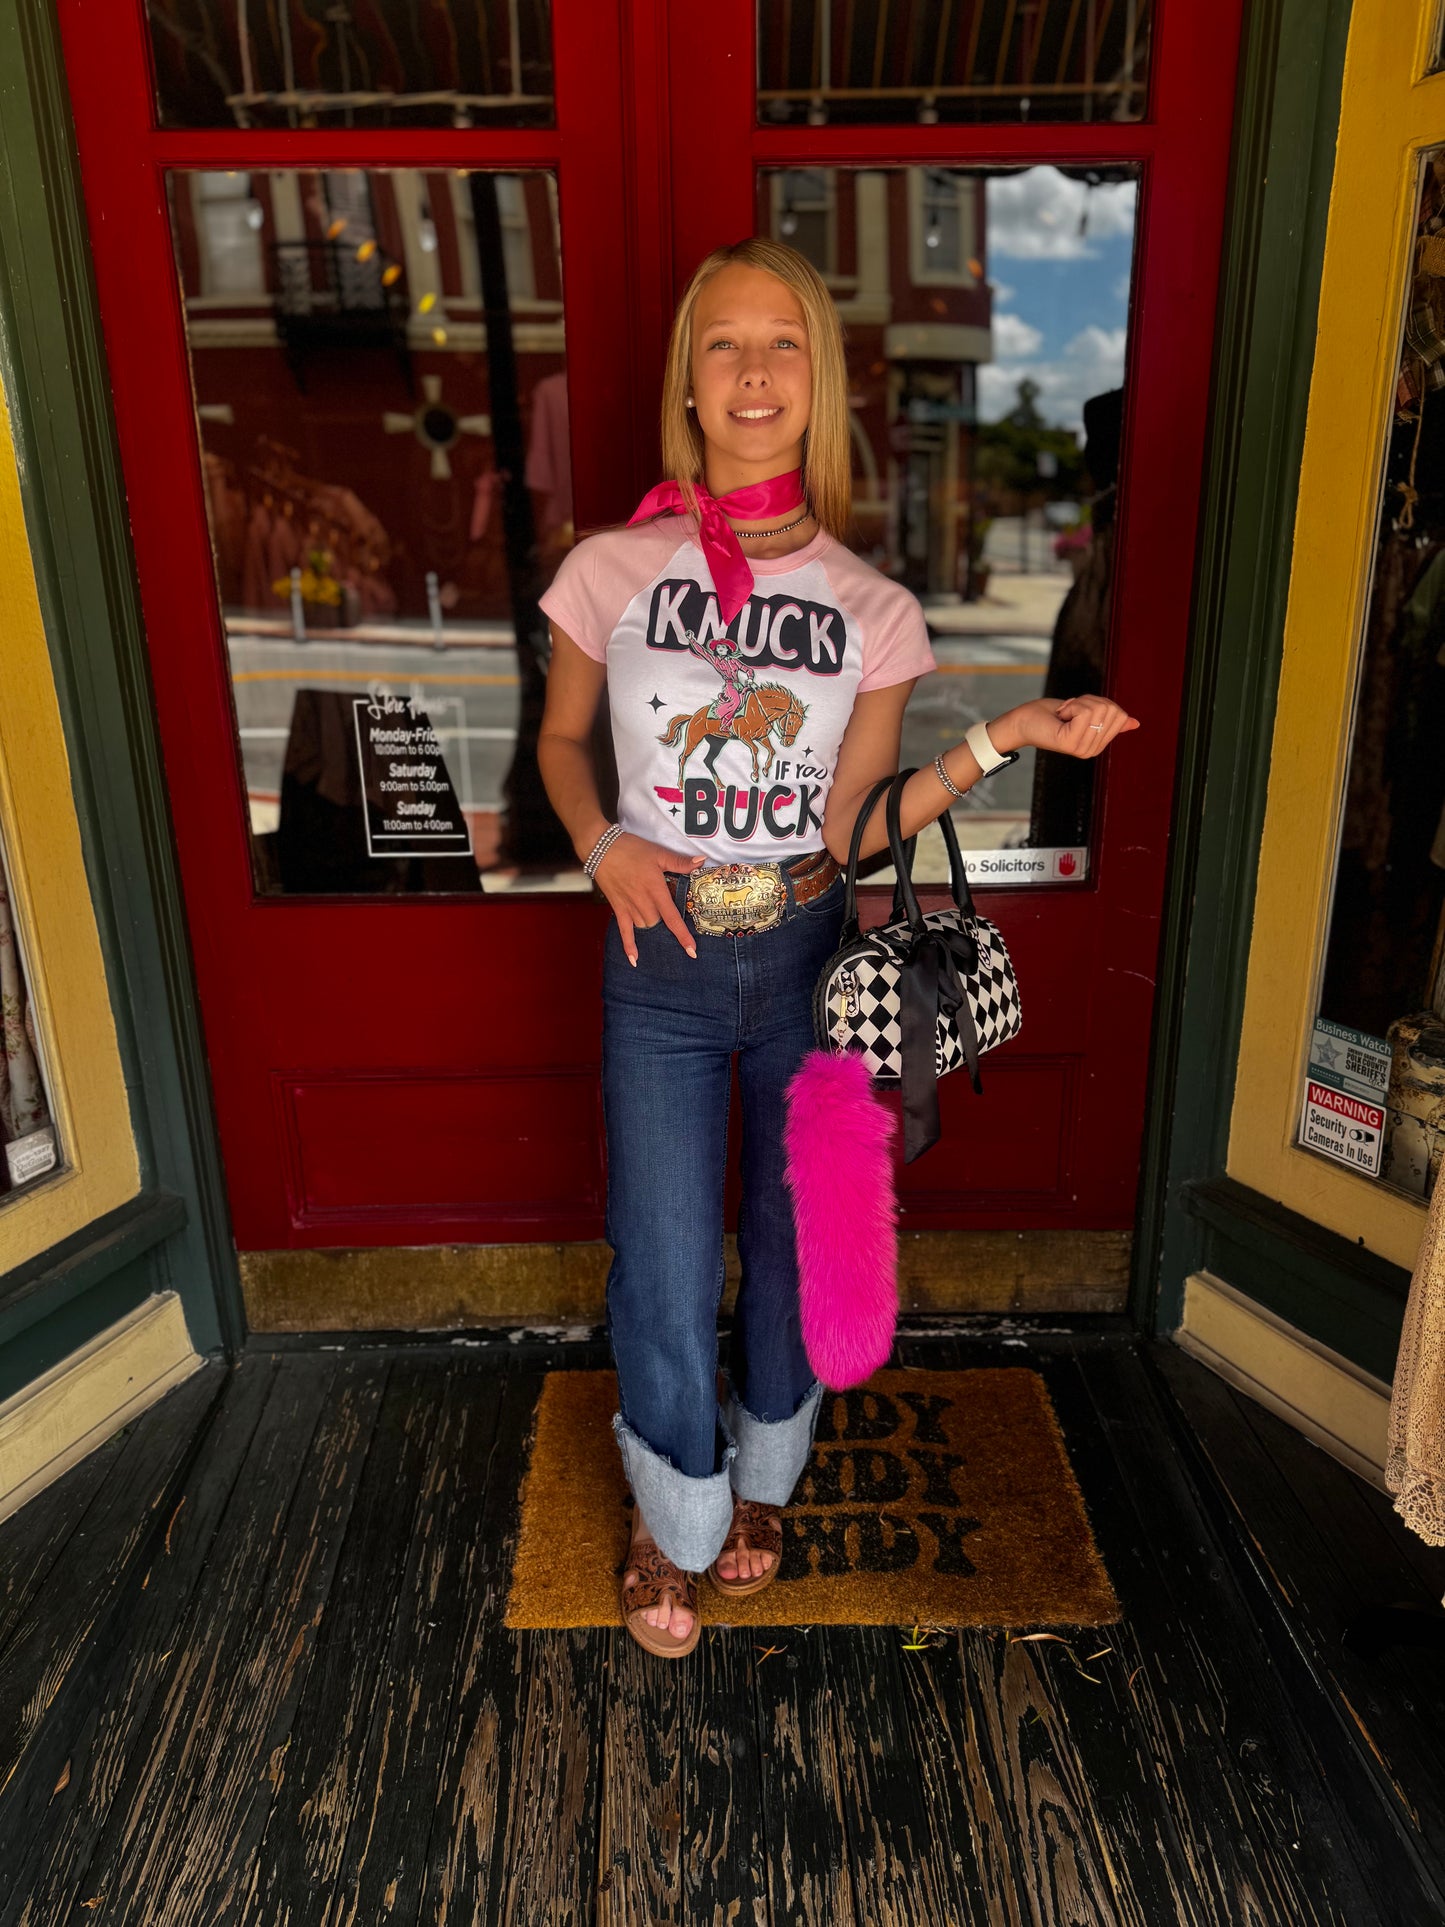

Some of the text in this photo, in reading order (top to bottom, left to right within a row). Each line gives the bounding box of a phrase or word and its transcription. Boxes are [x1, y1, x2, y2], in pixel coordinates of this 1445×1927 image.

[653, 583, 838, 665] KNUCK
[408, 745, 417, 755] to
[389, 763, 437, 780] Saturday
[775, 760, 829, 781] IF YOU
[379, 781, 410, 792] 9:00am
[410, 781, 419, 792] to
[397, 801, 437, 817] Sunday
[683, 777, 824, 841] BUCK
[414, 820, 423, 831] to
[423, 820, 453, 832] 4:00pm
[965, 859, 1046, 873] o Solicitors
[1316, 1019, 1392, 1056] Business Watch
[1346, 1053, 1387, 1073] POLK COUNTY
[1311, 1086, 1379, 1126] WARNING
[1310, 1108, 1347, 1139] Security
[1308, 1127, 1373, 1167] Cameras In Use
